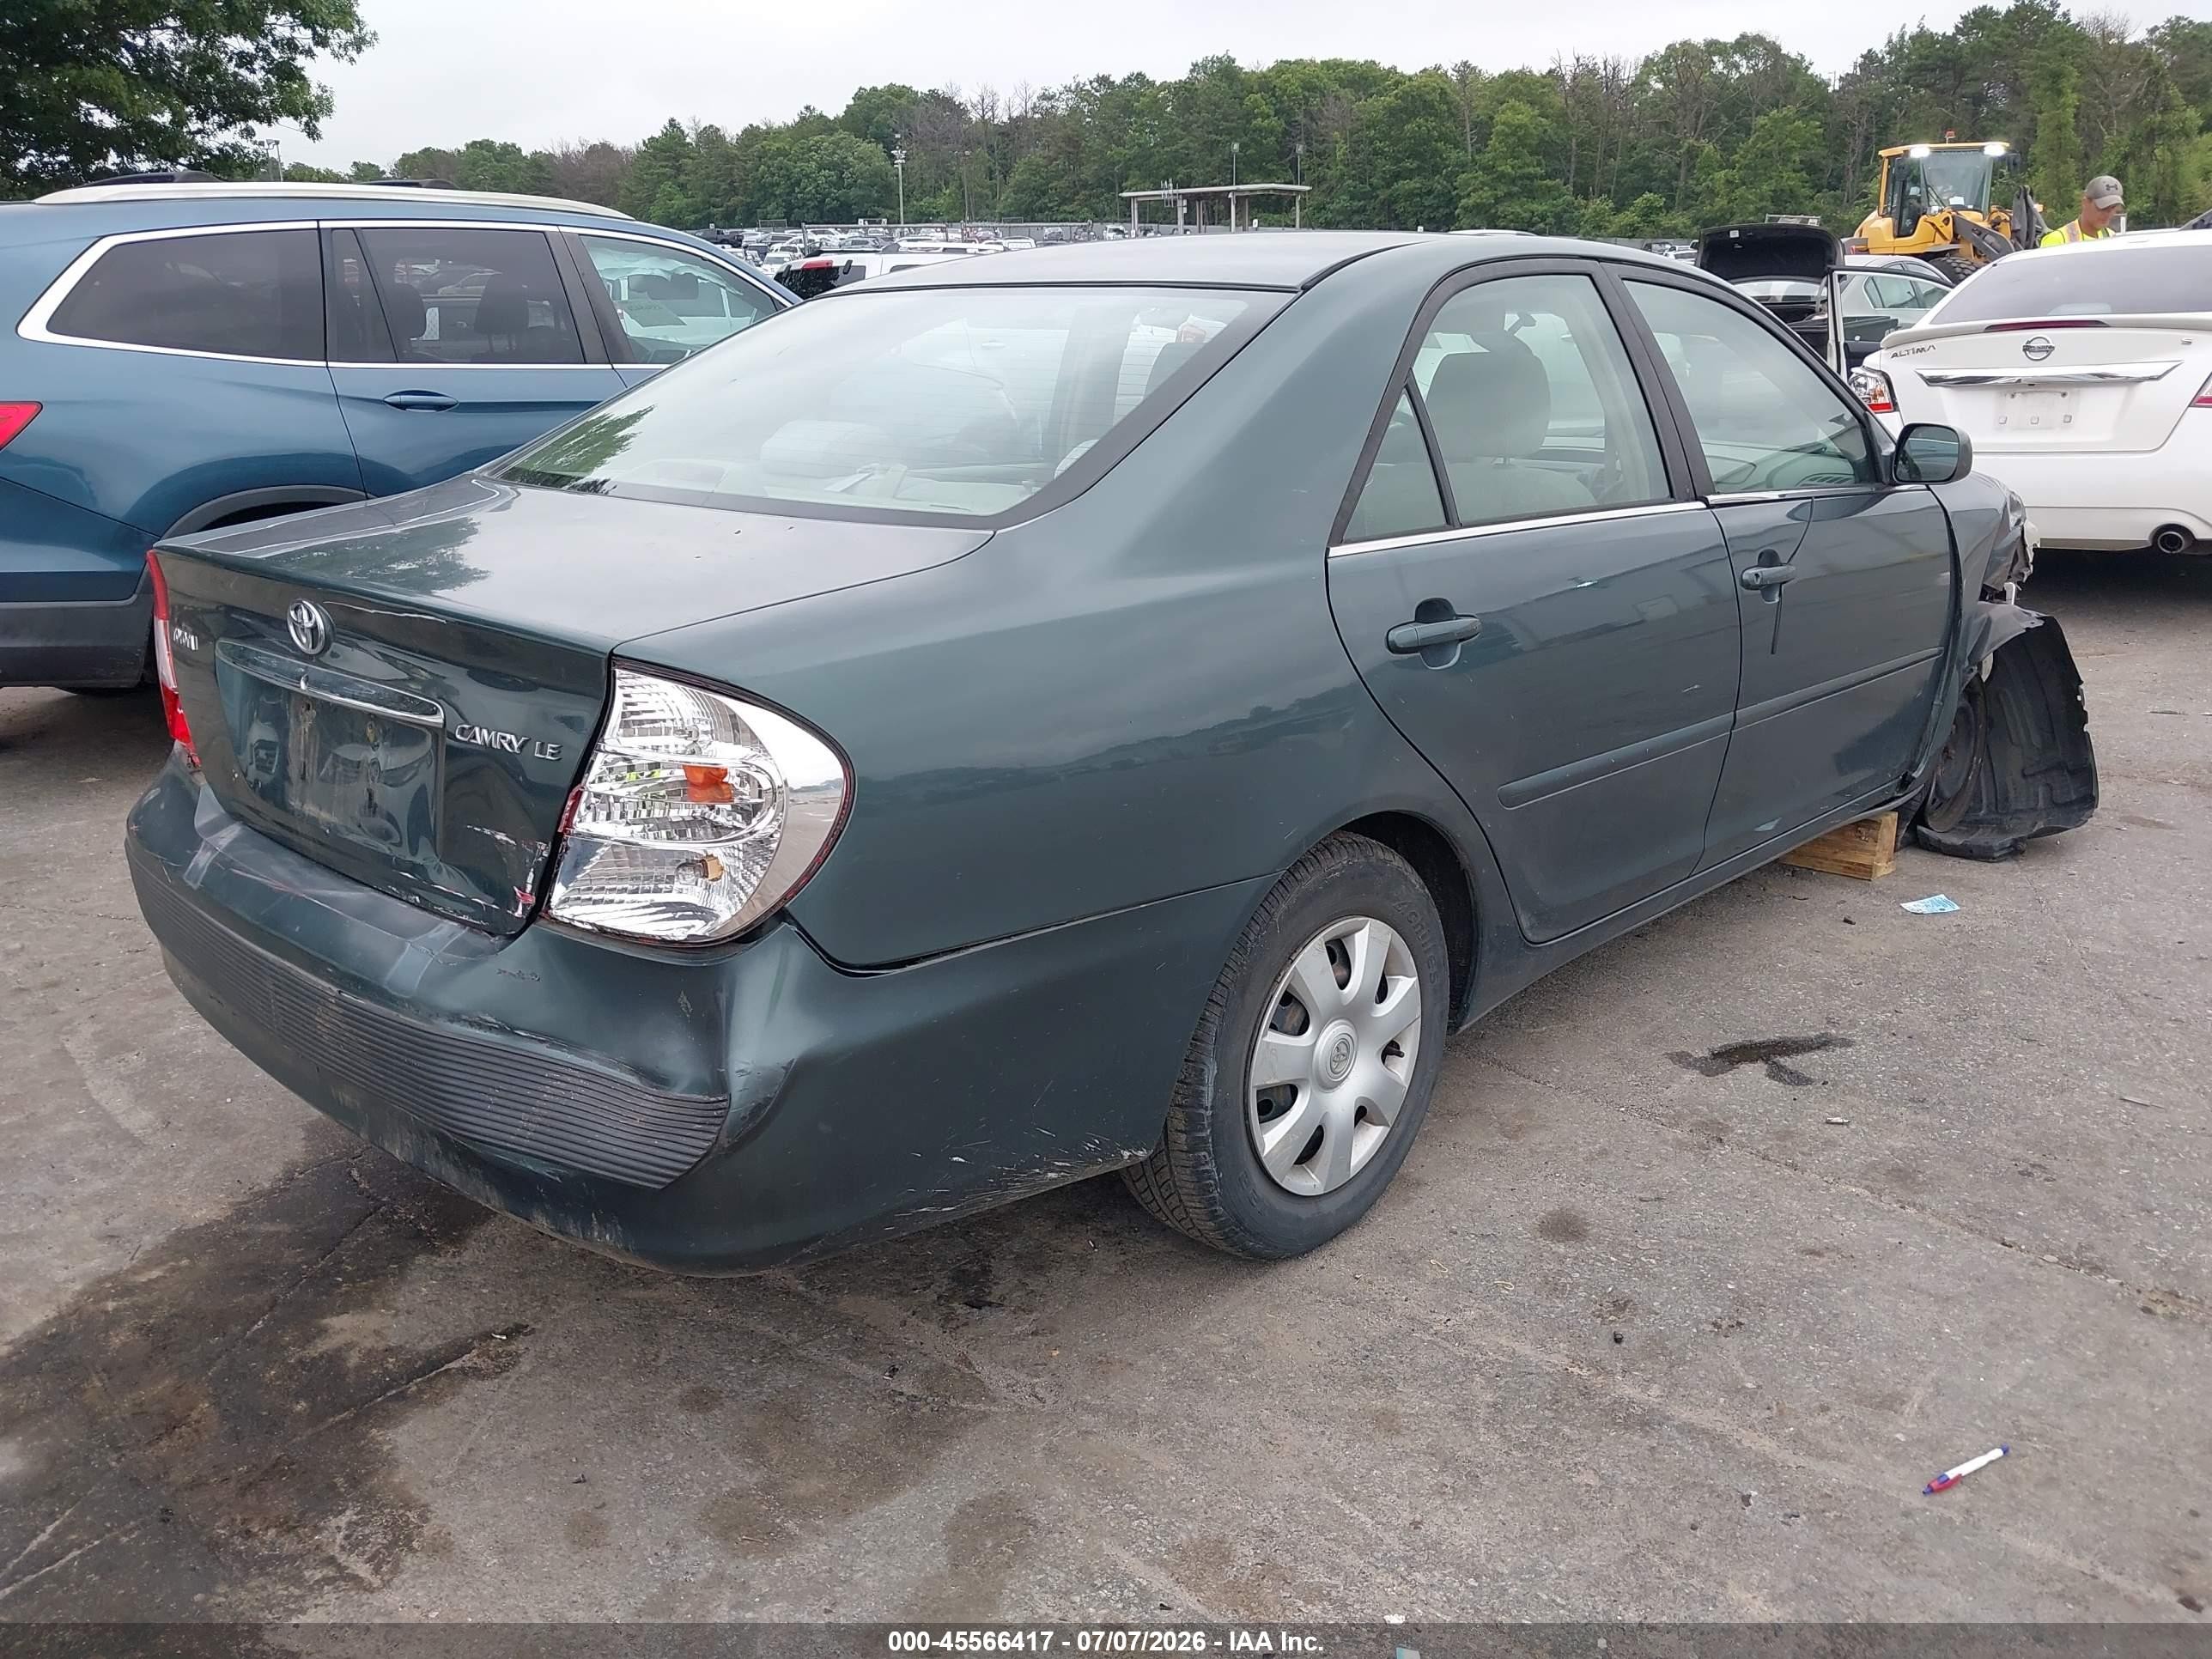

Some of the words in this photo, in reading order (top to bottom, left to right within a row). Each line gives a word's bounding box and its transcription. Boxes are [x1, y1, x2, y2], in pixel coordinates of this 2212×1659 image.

[1890, 344, 1936, 359] ALTIMA
[455, 724, 531, 754] CAMRY
[534, 741, 562, 761] LE
